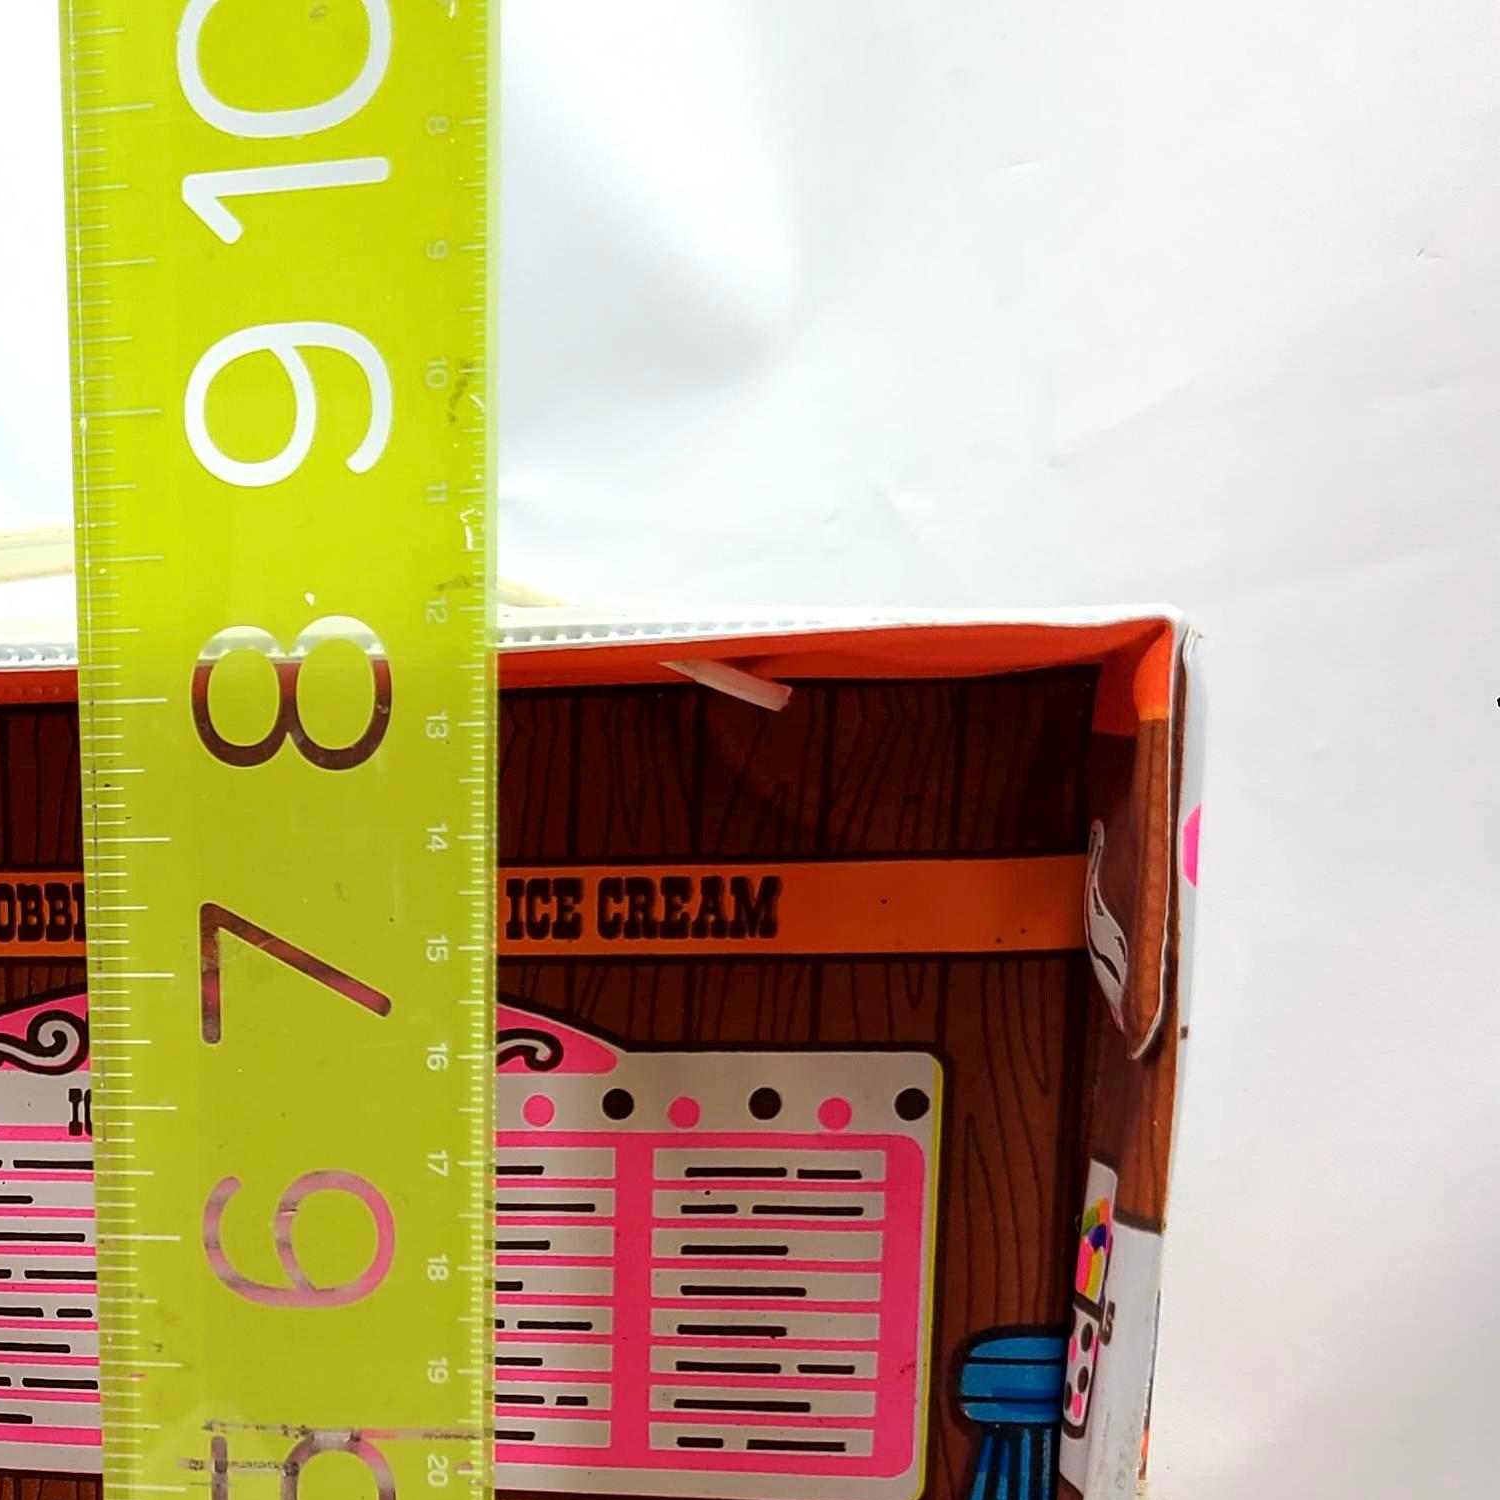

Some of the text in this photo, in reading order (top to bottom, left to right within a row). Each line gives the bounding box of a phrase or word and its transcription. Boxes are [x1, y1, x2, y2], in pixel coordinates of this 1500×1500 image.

[177, 0, 392, 244] 10
[425, 357, 449, 389] 10
[185, 321, 393, 488] 9
[425, 482, 449, 504] 11
[425, 598, 449, 625] 12
[190, 615, 393, 770] 8
[425, 712, 449, 740] 13
[426, 823, 449, 852] 14
[505, 877, 584, 941] ICE
[597, 875, 782, 940] CREAM
[426, 935, 449, 962] 15
[200, 902, 392, 1044] 7
[426, 1043, 449, 1071] 16
[427, 1150, 449, 1176] 17
[202, 1170, 396, 1308] 6
[427, 1255, 449, 1282] 18
[427, 1358, 449, 1384] 19
[427, 1455, 450, 1487] 20
